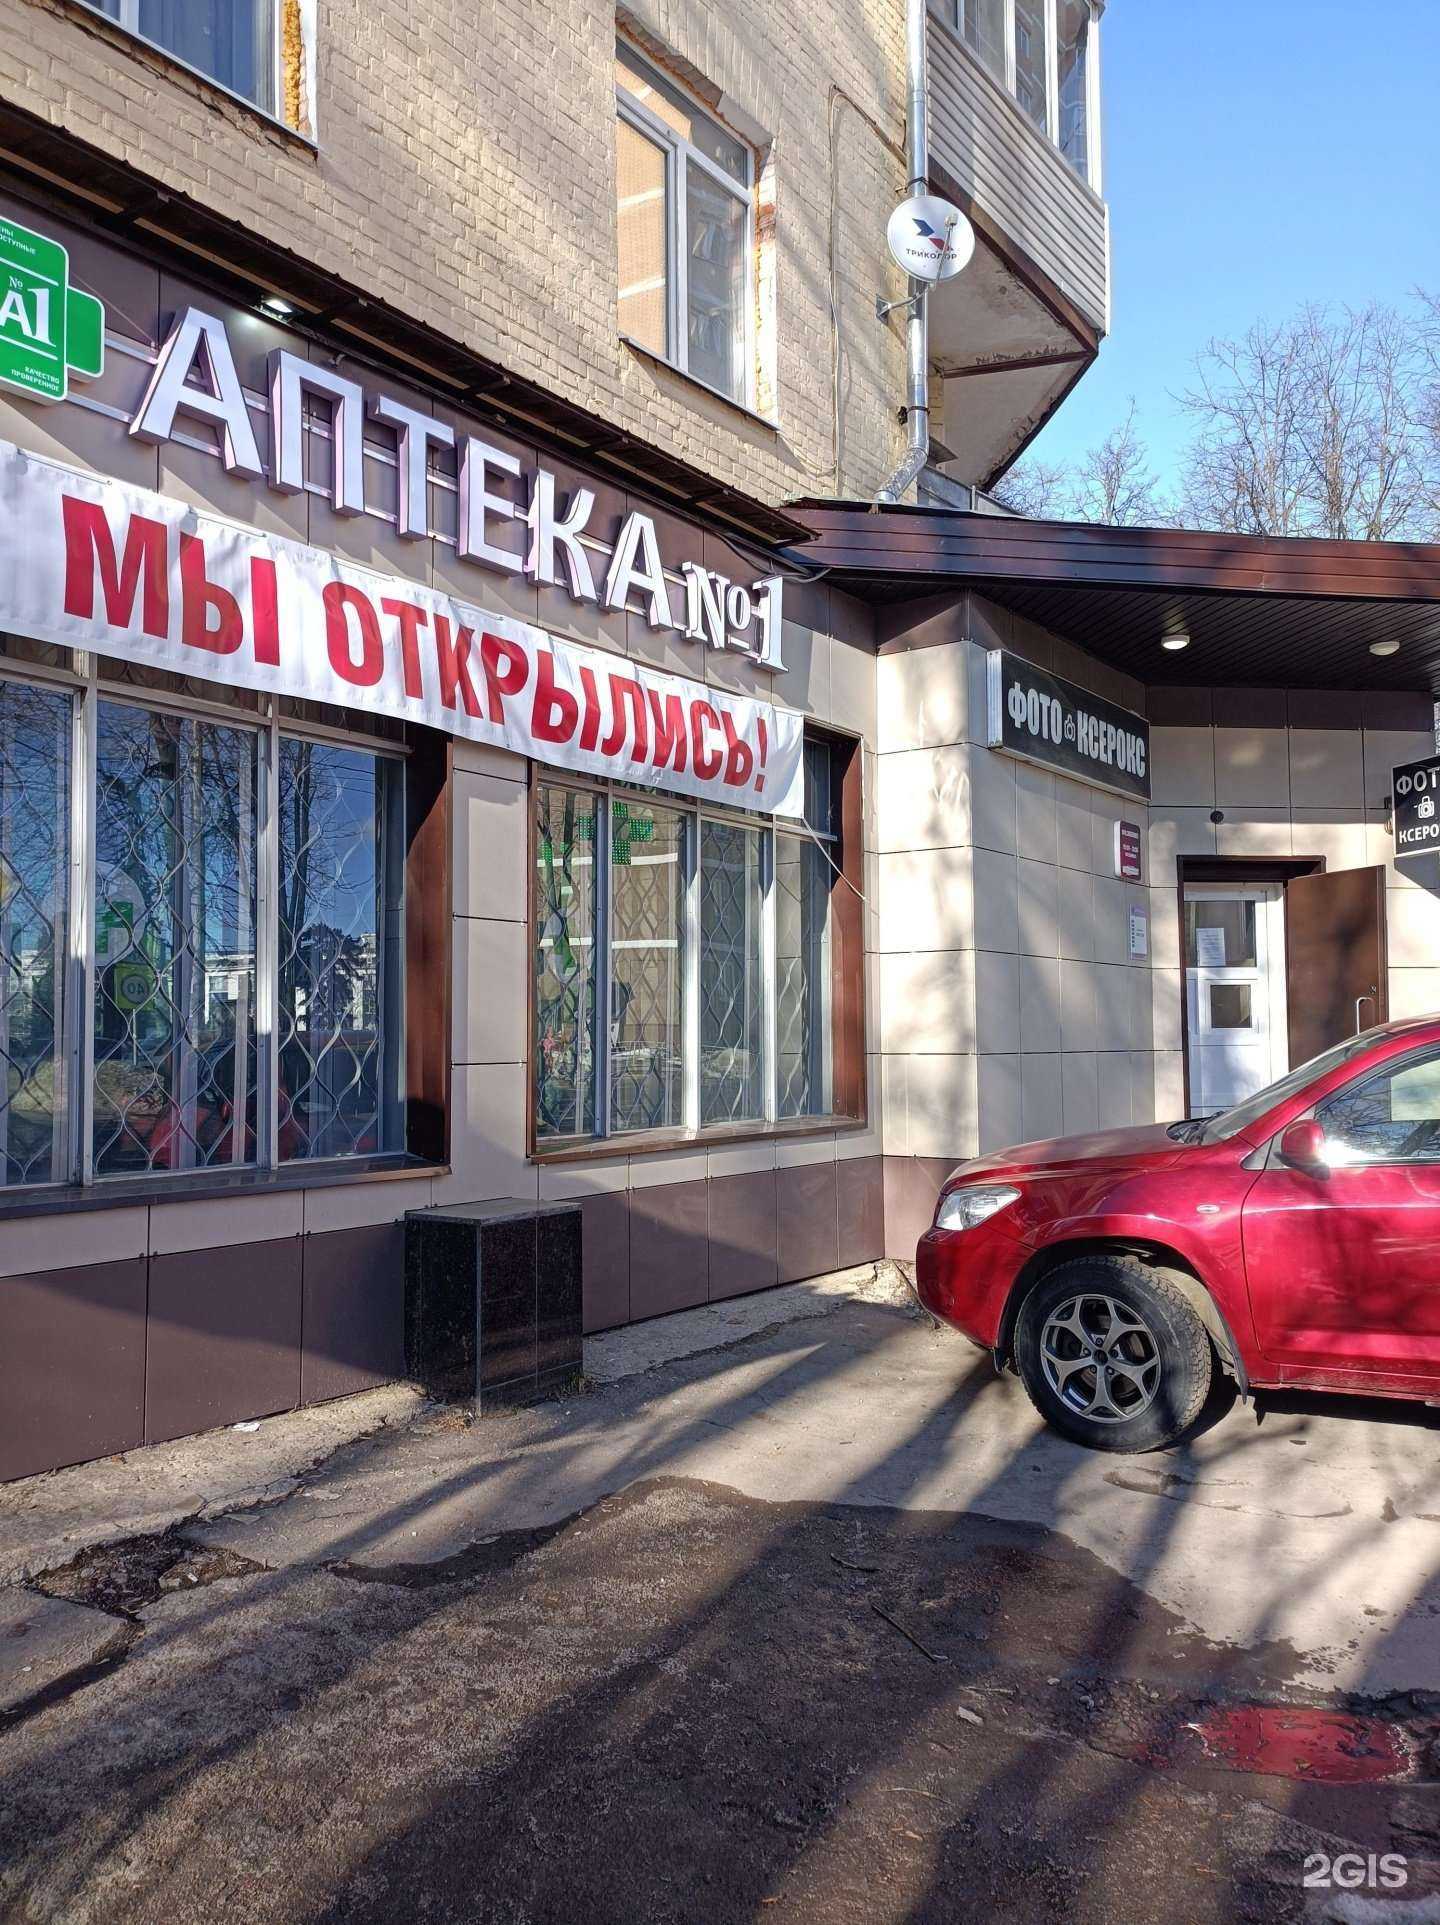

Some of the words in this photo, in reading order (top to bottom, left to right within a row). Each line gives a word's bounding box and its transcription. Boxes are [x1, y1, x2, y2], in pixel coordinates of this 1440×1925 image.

[11, 369, 59, 391] ПРОВЕРЕННОЕ
[25, 366, 59, 384] КАЧЕСТВО
[129, 304, 675, 632] АПТЕКА
[681, 560, 789, 675] №1
[61, 495, 281, 667] МЫ
[322, 580, 769, 793] ОТКРЫЛИСЬ!
[1008, 681, 1062, 745] ФОТО
[1076, 710, 1146, 778] КСЕРОКС
